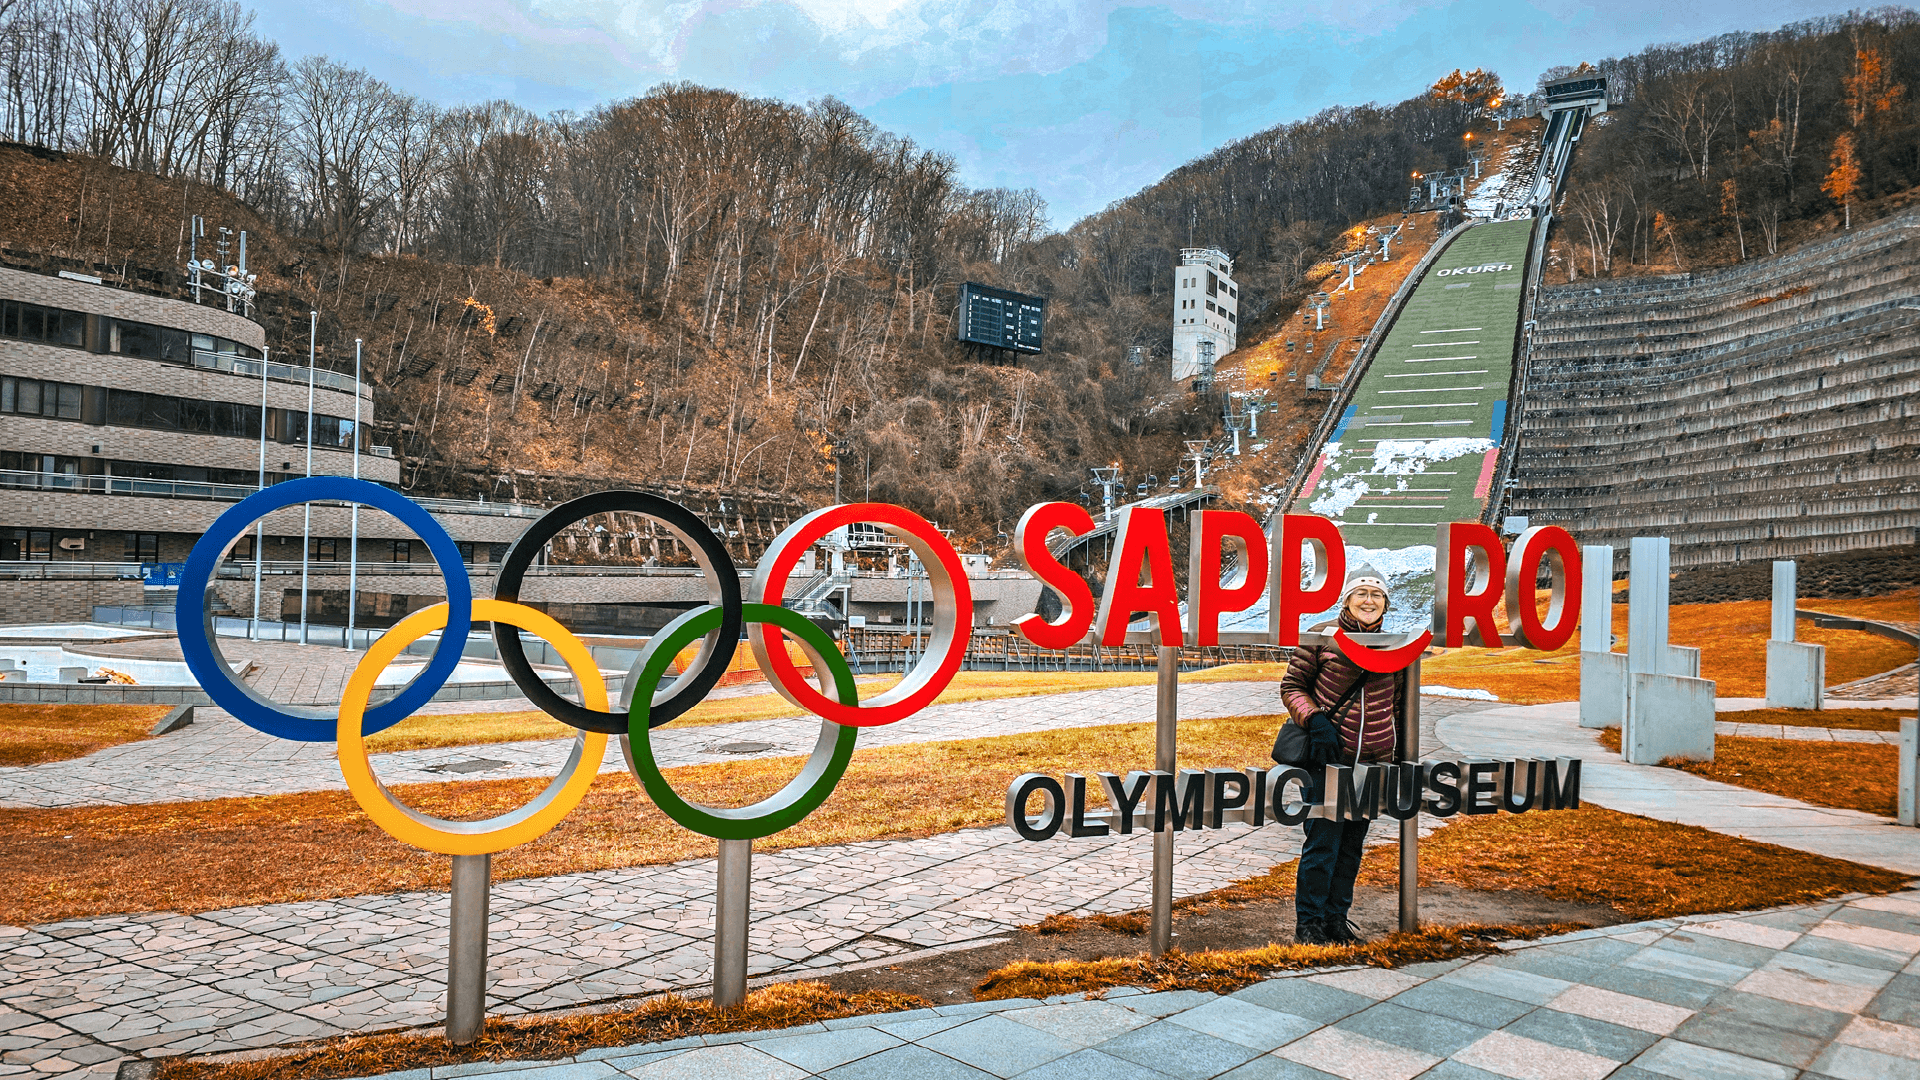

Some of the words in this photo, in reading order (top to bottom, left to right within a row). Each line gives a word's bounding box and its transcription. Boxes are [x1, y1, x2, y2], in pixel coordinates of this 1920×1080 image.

[1436, 264, 1513, 277] OKURA
[1014, 501, 1582, 652] SAPPRO
[1011, 766, 1313, 842] OLYMPIC
[1338, 758, 1581, 823] MUSEUM
